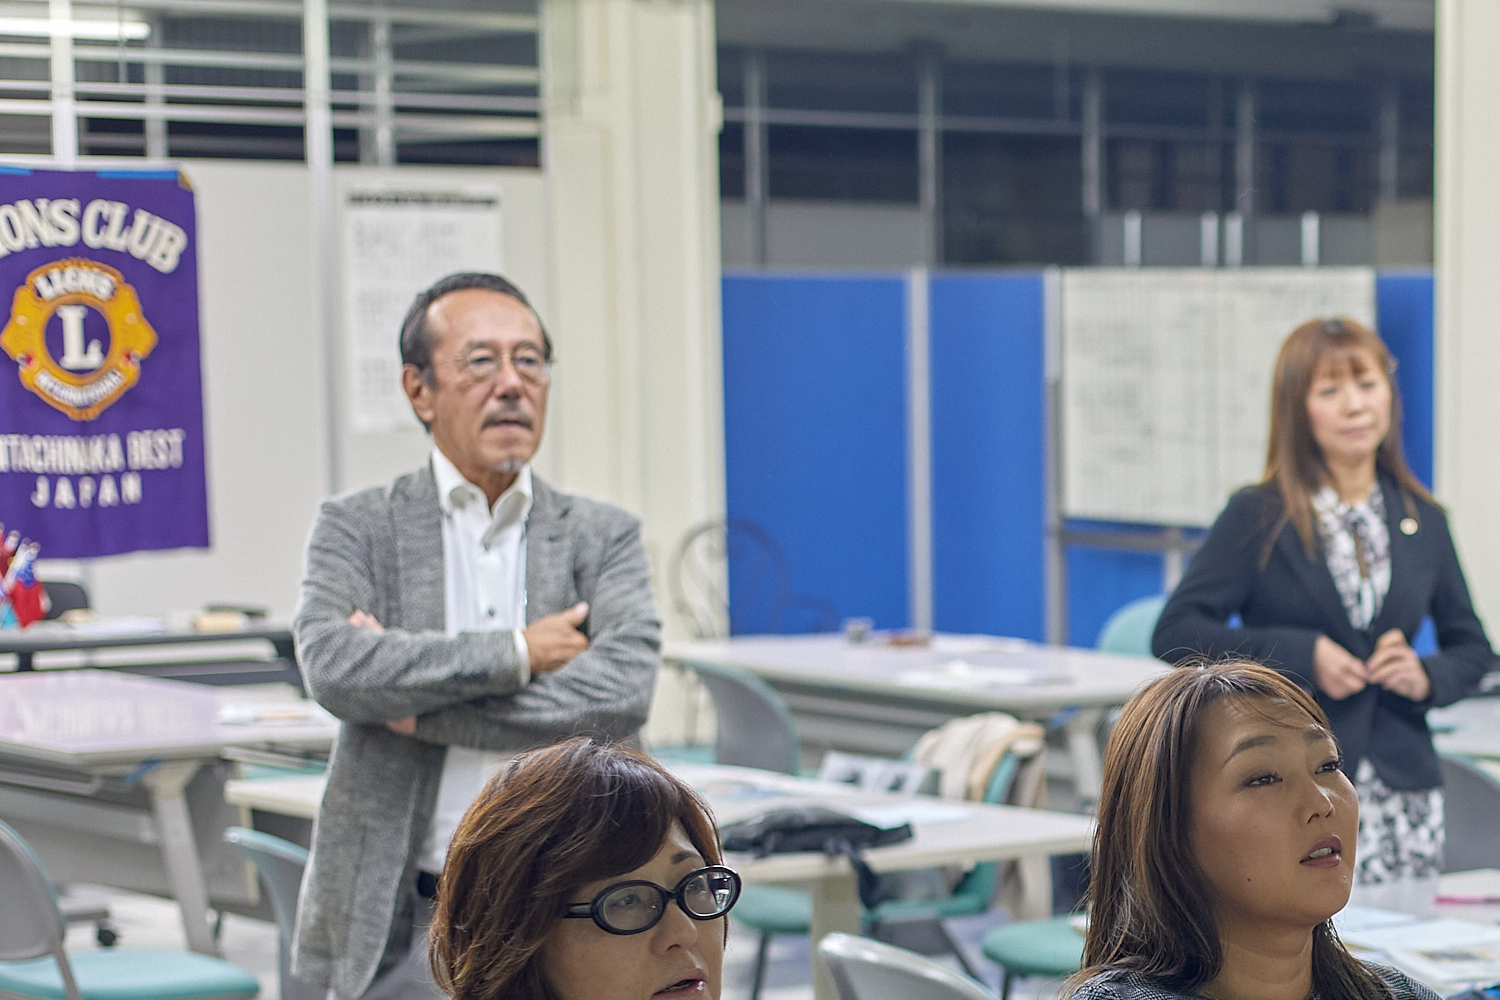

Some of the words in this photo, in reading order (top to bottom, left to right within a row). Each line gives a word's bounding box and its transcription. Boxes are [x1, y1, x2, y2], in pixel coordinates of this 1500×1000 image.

[0, 198, 81, 259] ONS
[81, 199, 188, 274] CLUB
[57, 304, 105, 371] L
[31, 471, 142, 509] JAPAN
